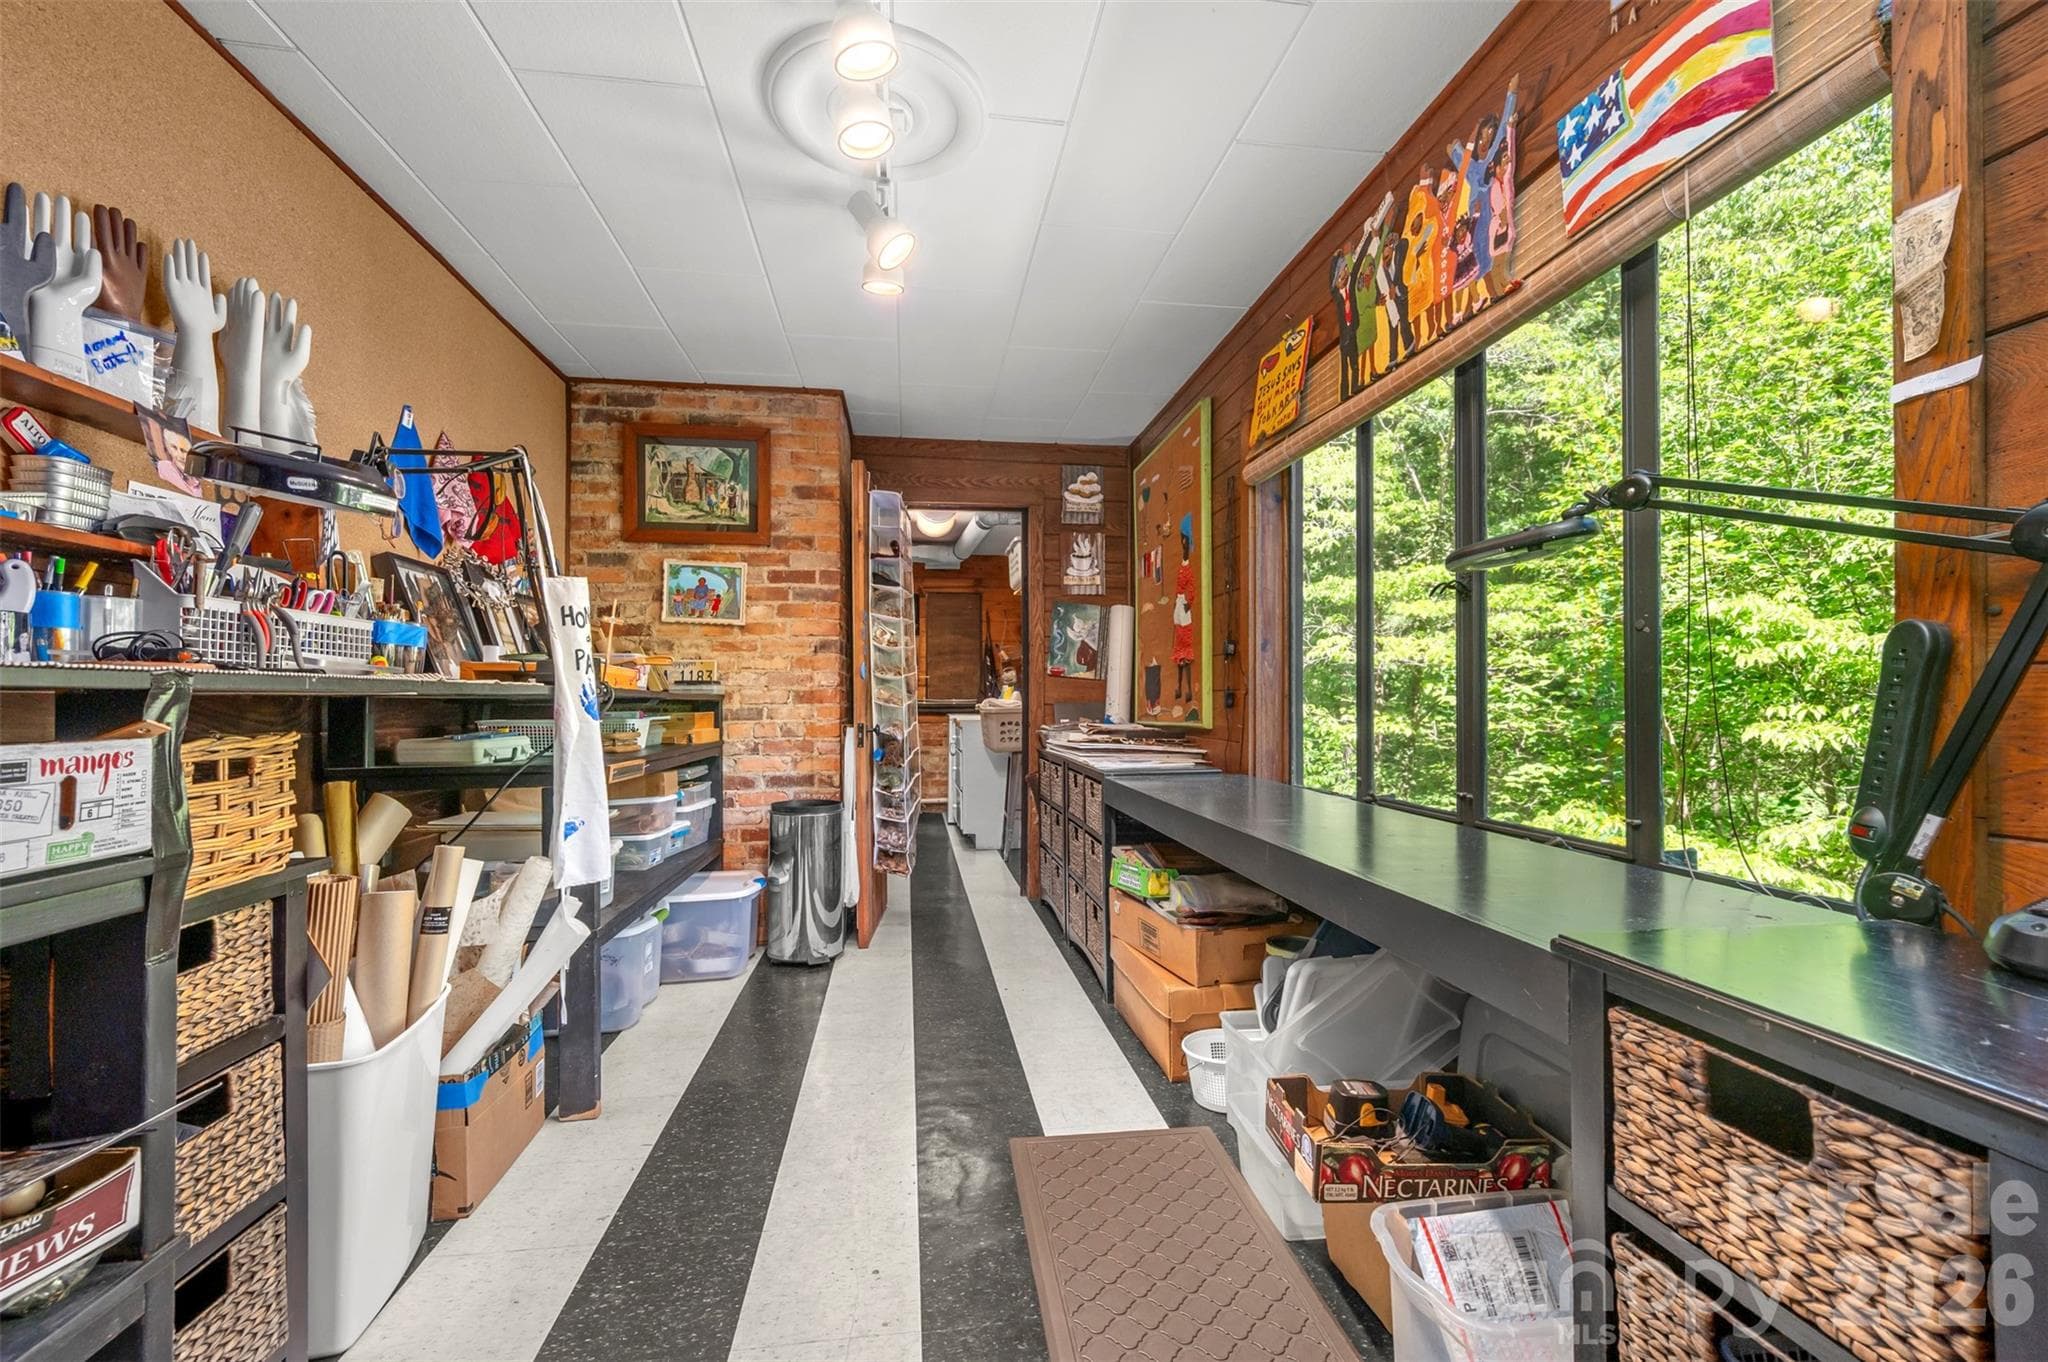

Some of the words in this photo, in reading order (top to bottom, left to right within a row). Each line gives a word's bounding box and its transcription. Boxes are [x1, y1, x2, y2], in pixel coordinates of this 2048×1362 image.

[21, 418, 46, 445] ALTO
[39, 751, 135, 795] mangos
[51, 842, 88, 856] HAPPY
[1363, 1174, 1509, 1198] NECTARINES
